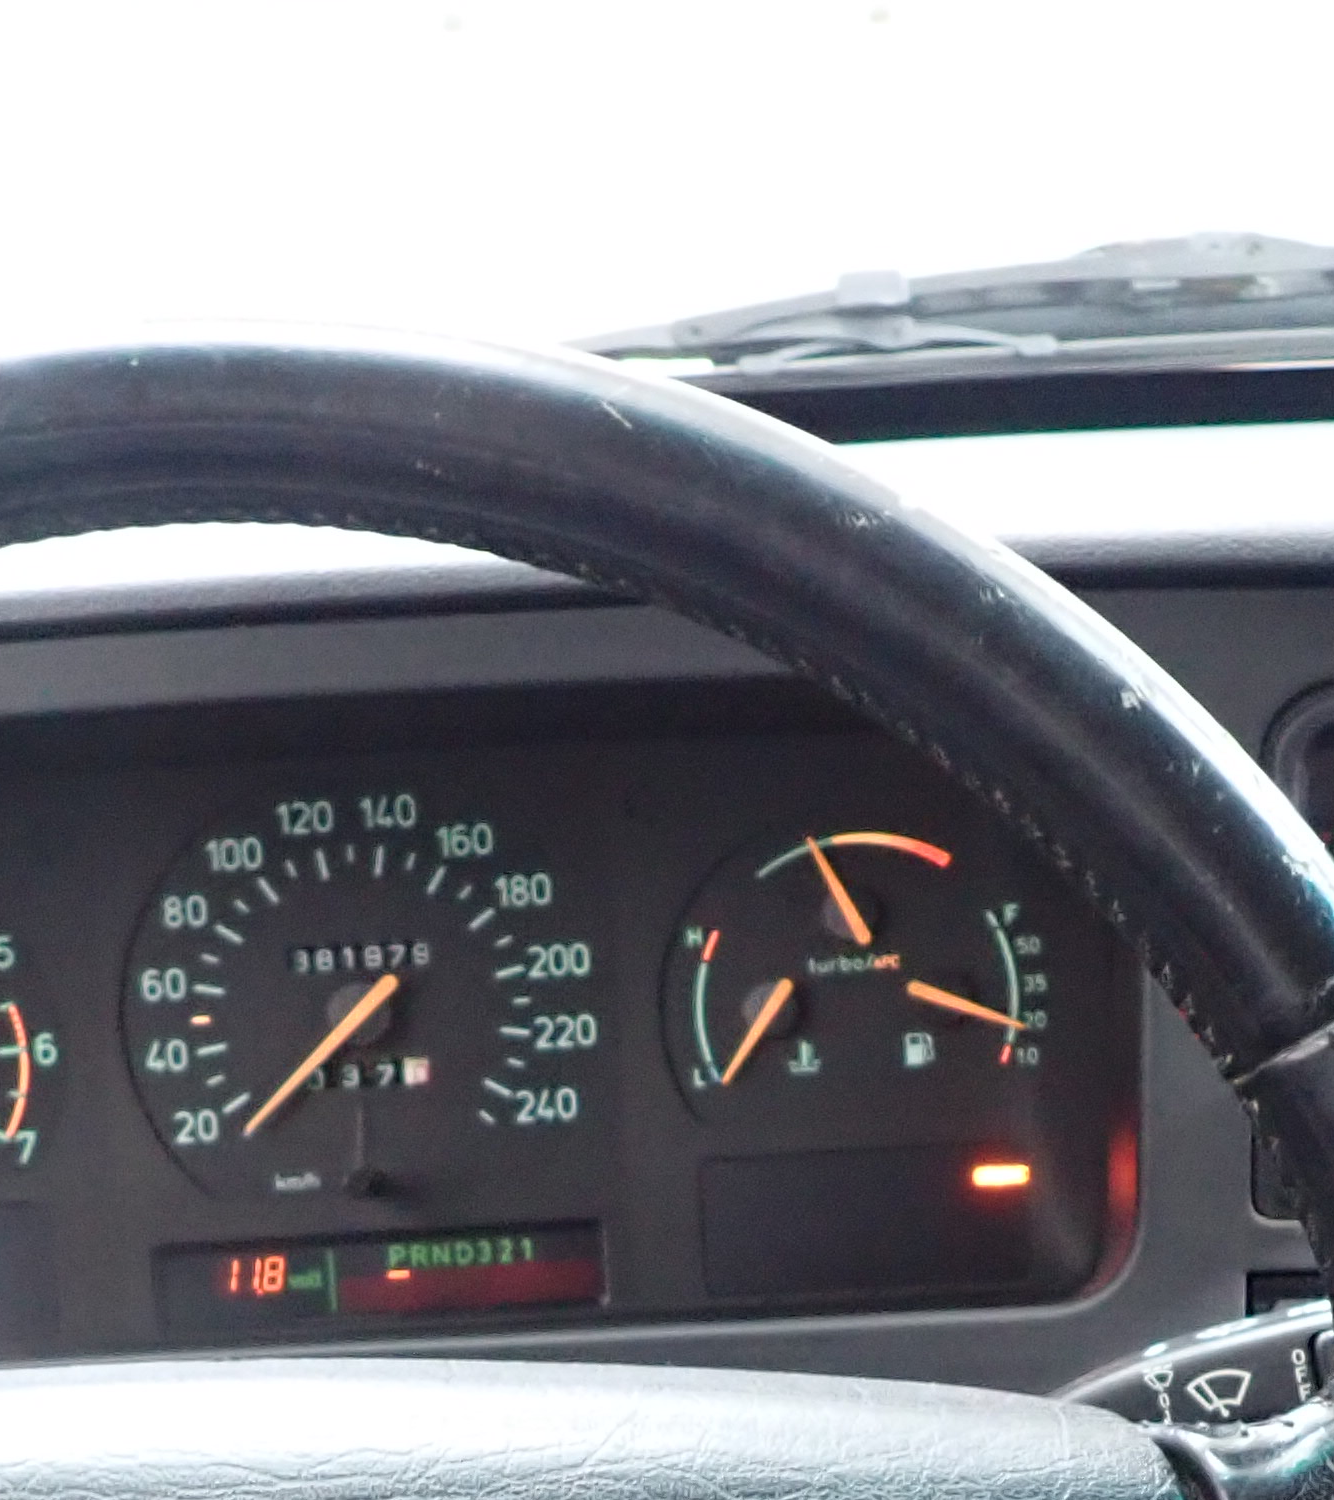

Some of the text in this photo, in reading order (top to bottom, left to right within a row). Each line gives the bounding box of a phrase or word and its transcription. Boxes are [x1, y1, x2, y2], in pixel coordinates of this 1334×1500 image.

[276, 800, 334, 835] 120
[361, 794, 416, 828] 140
[205, 836, 263, 872] 100
[435, 822, 493, 857] 160
[495, 872, 551, 907] 180
[165, 895, 208, 930] 80
[685, 926, 704, 948] H
[1017, 935, 1041, 954] 50
[527, 943, 591, 979] 200
[141, 967, 187, 1002] 60
[534, 1014, 597, 1049] 220
[33, 1032, 58, 1068] 6
[145, 1038, 189, 1073] 40
[693, 1067, 707, 1089] L
[517, 1087, 578, 1122] 240
[173, 1109, 219, 1145] 20
[16, 1130, 39, 1166] 7
